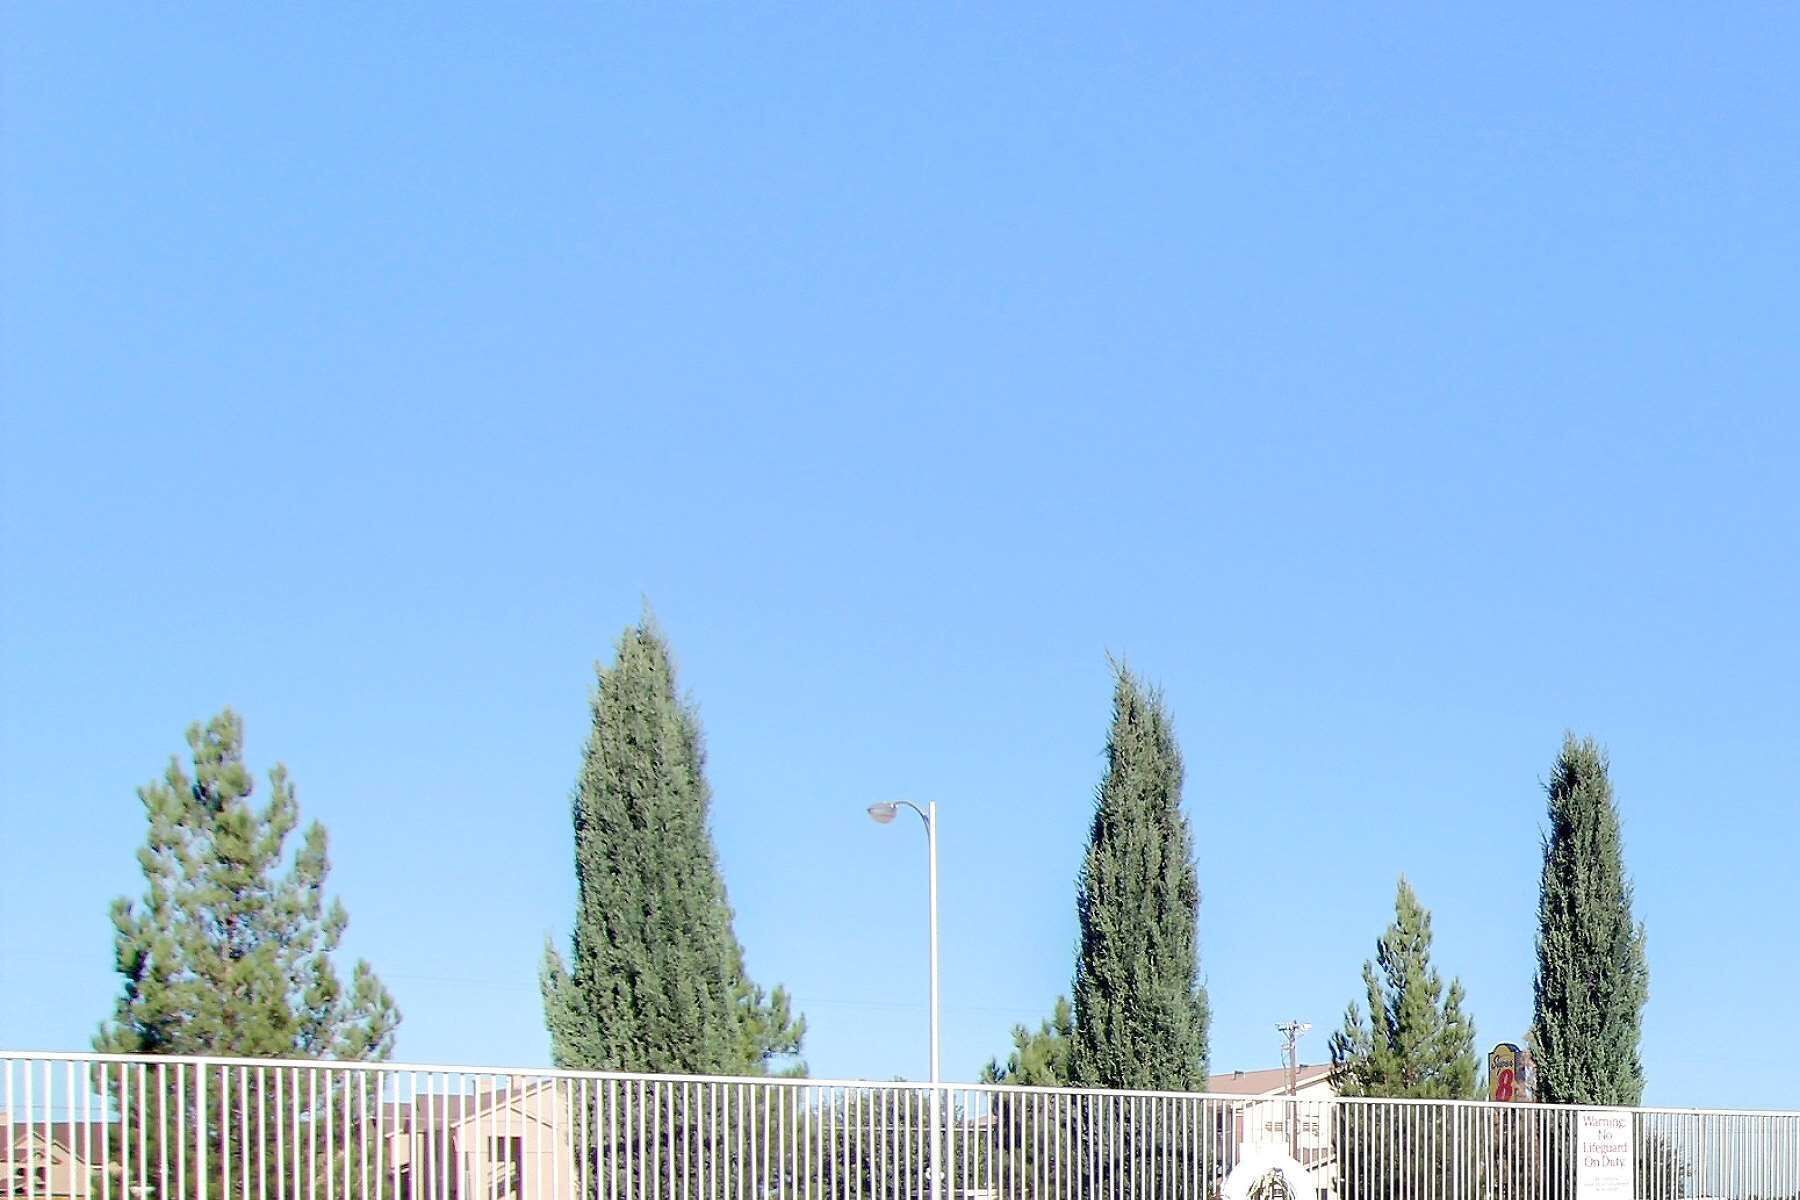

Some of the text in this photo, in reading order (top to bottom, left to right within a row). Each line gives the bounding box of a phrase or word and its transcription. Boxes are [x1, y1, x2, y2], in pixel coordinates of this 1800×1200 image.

[1495, 1069, 1514, 1102] 8
[1599, 1129, 1613, 1140] No
[1583, 1141, 1628, 1156] Lifeguard
[1584, 1156, 1600, 1167] On
